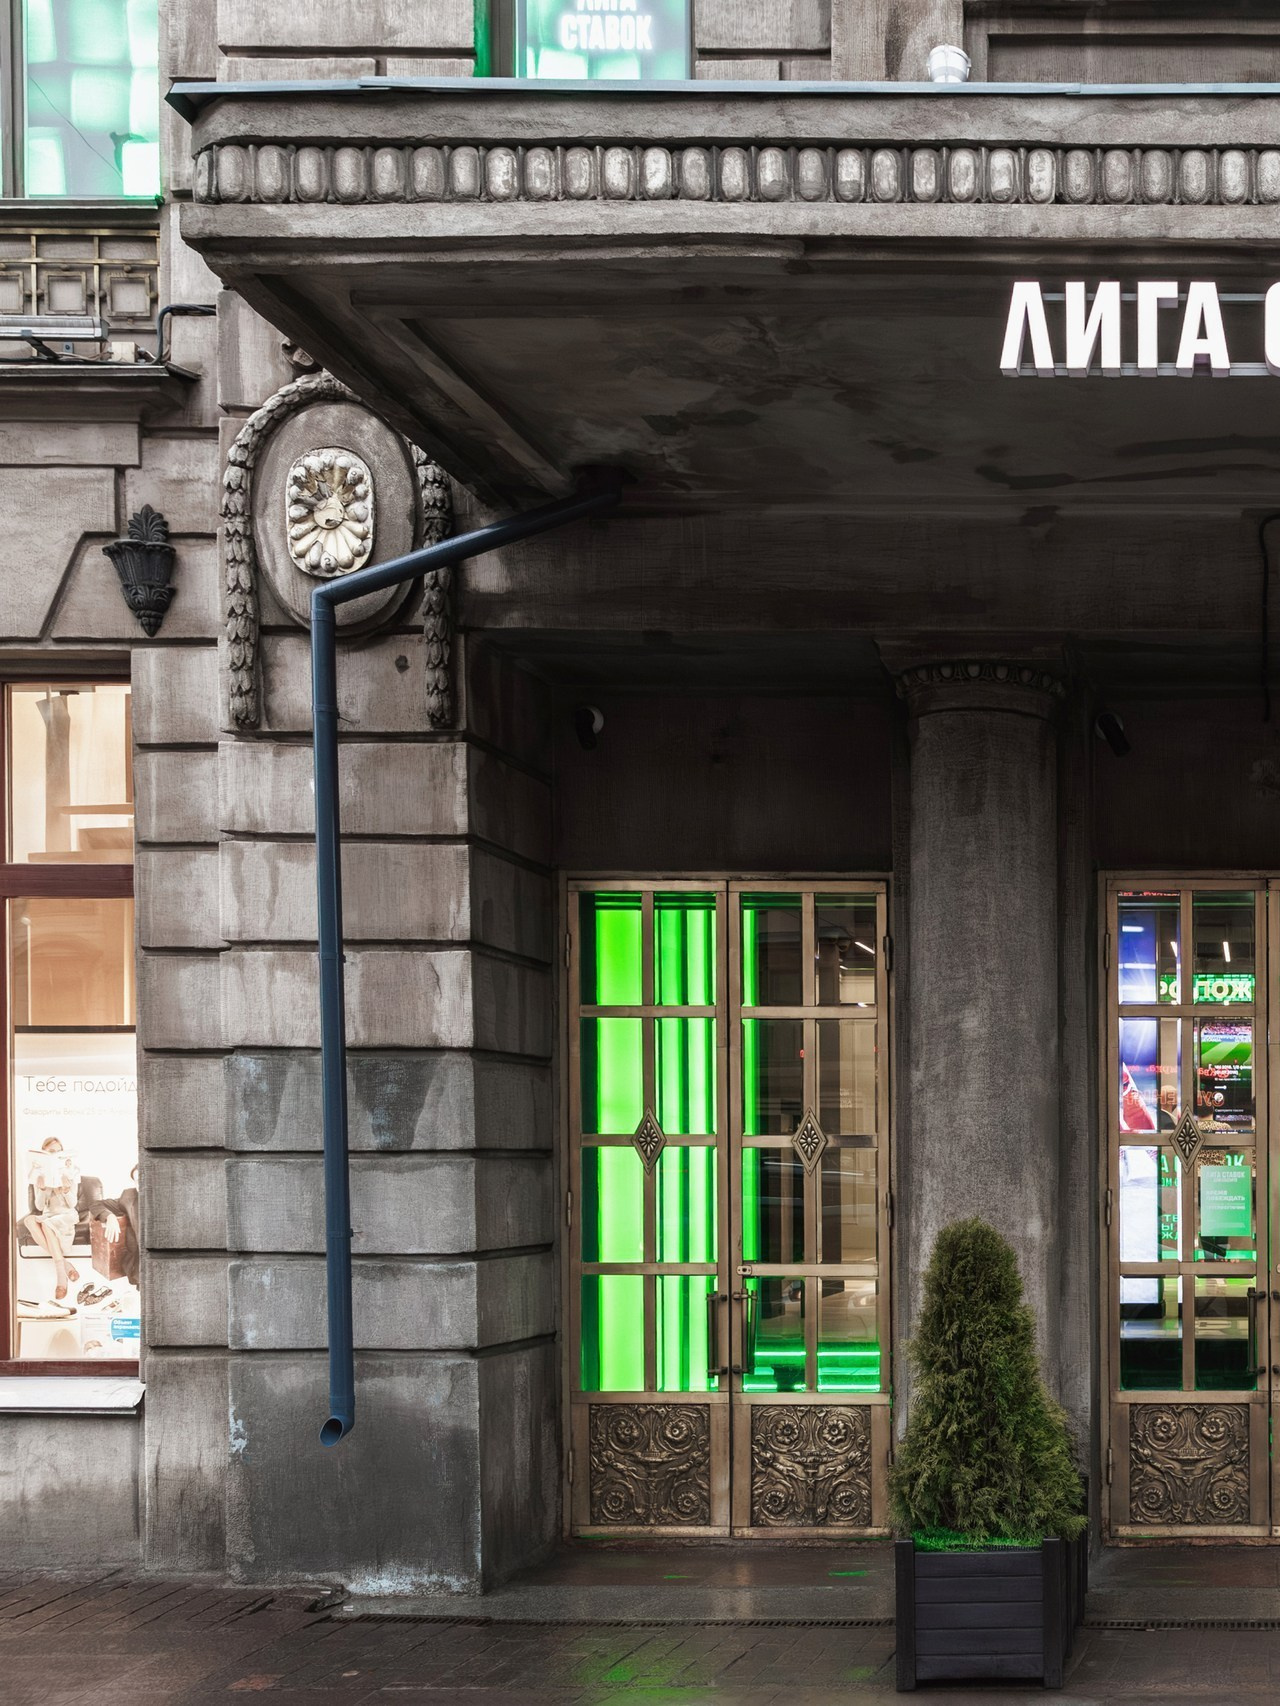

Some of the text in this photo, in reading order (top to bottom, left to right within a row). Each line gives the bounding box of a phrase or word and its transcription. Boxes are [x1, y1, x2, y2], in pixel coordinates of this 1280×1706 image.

[561, 15, 653, 50] СТАВОК
[1000, 280, 1231, 377] ЛИГА
[23, 1076, 138, 1093] Тебе подойд
